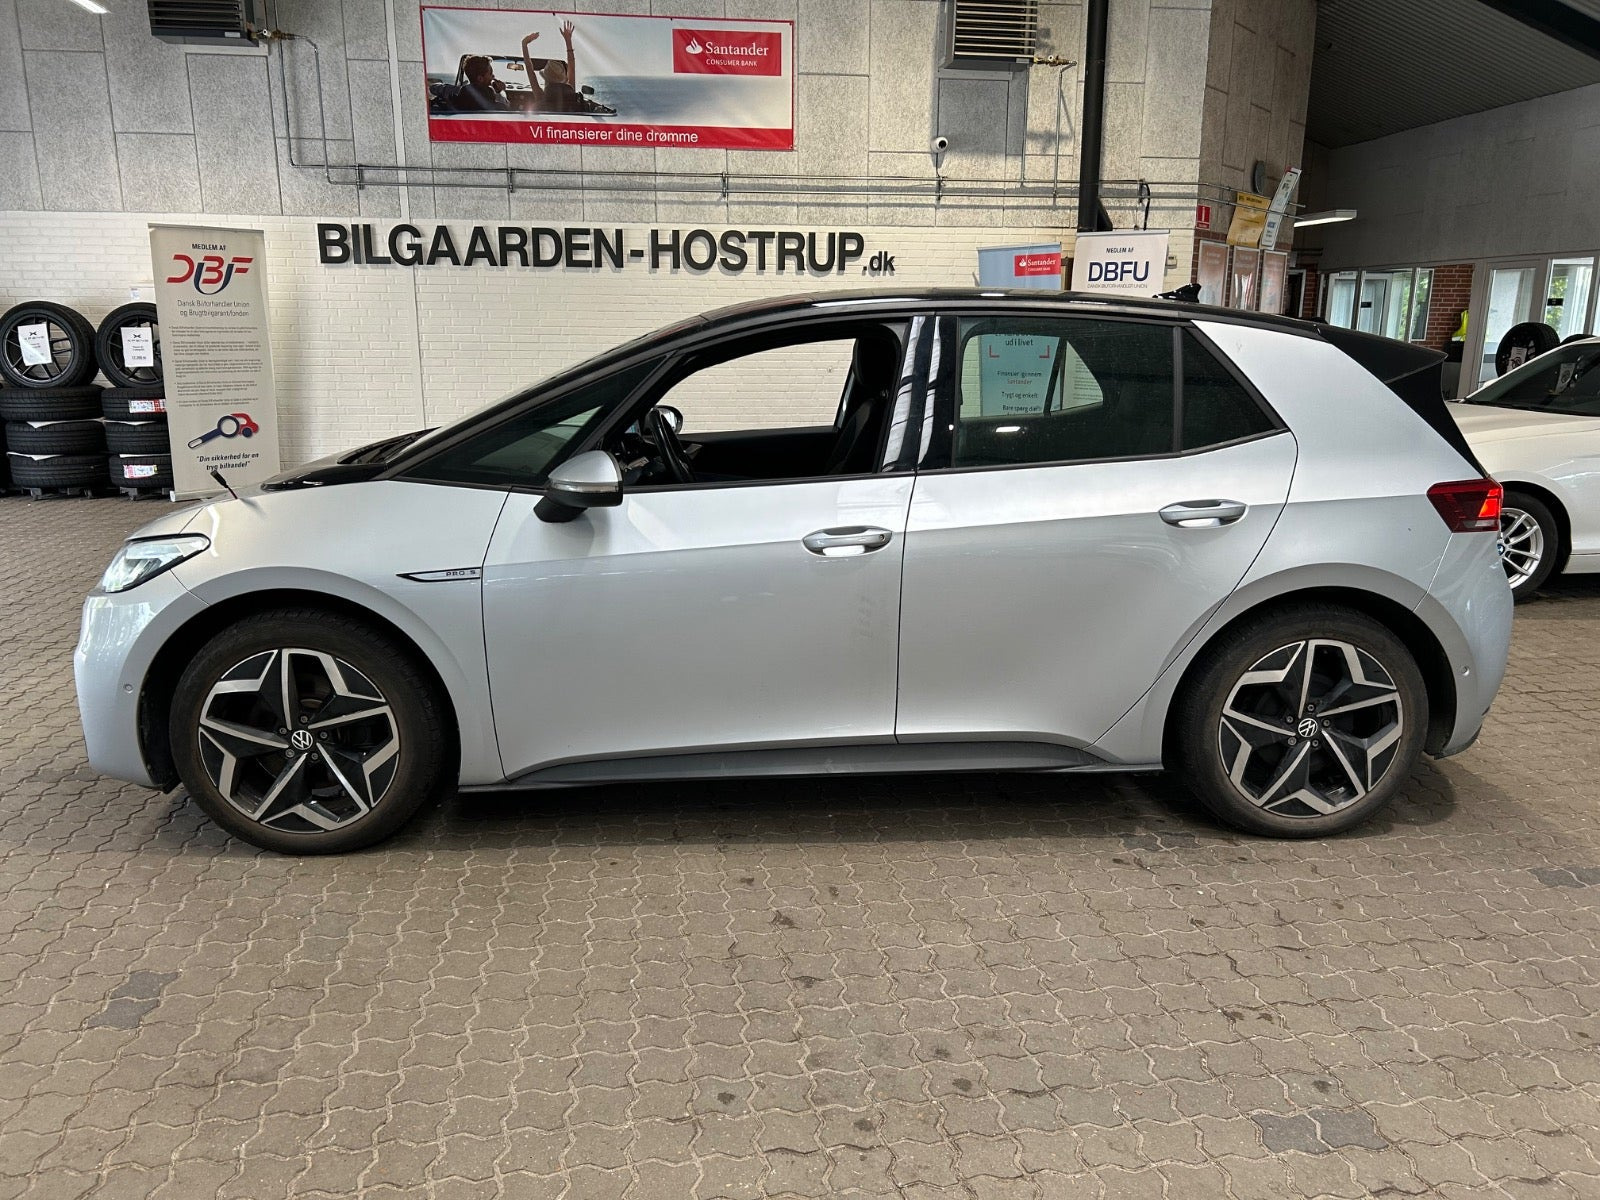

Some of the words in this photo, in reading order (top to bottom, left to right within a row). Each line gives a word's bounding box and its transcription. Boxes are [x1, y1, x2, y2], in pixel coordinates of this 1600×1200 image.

[705, 41, 769, 56] Santander
[706, 58, 740, 66] CONSUMER
[529, 126, 543, 139] Vi
[546, 126, 612, 140] finansierer
[616, 128, 643, 142] dine
[646, 129, 698, 143] drømme
[1027, 258, 1056, 266] Santander
[1088, 261, 1149, 281] DBFU
